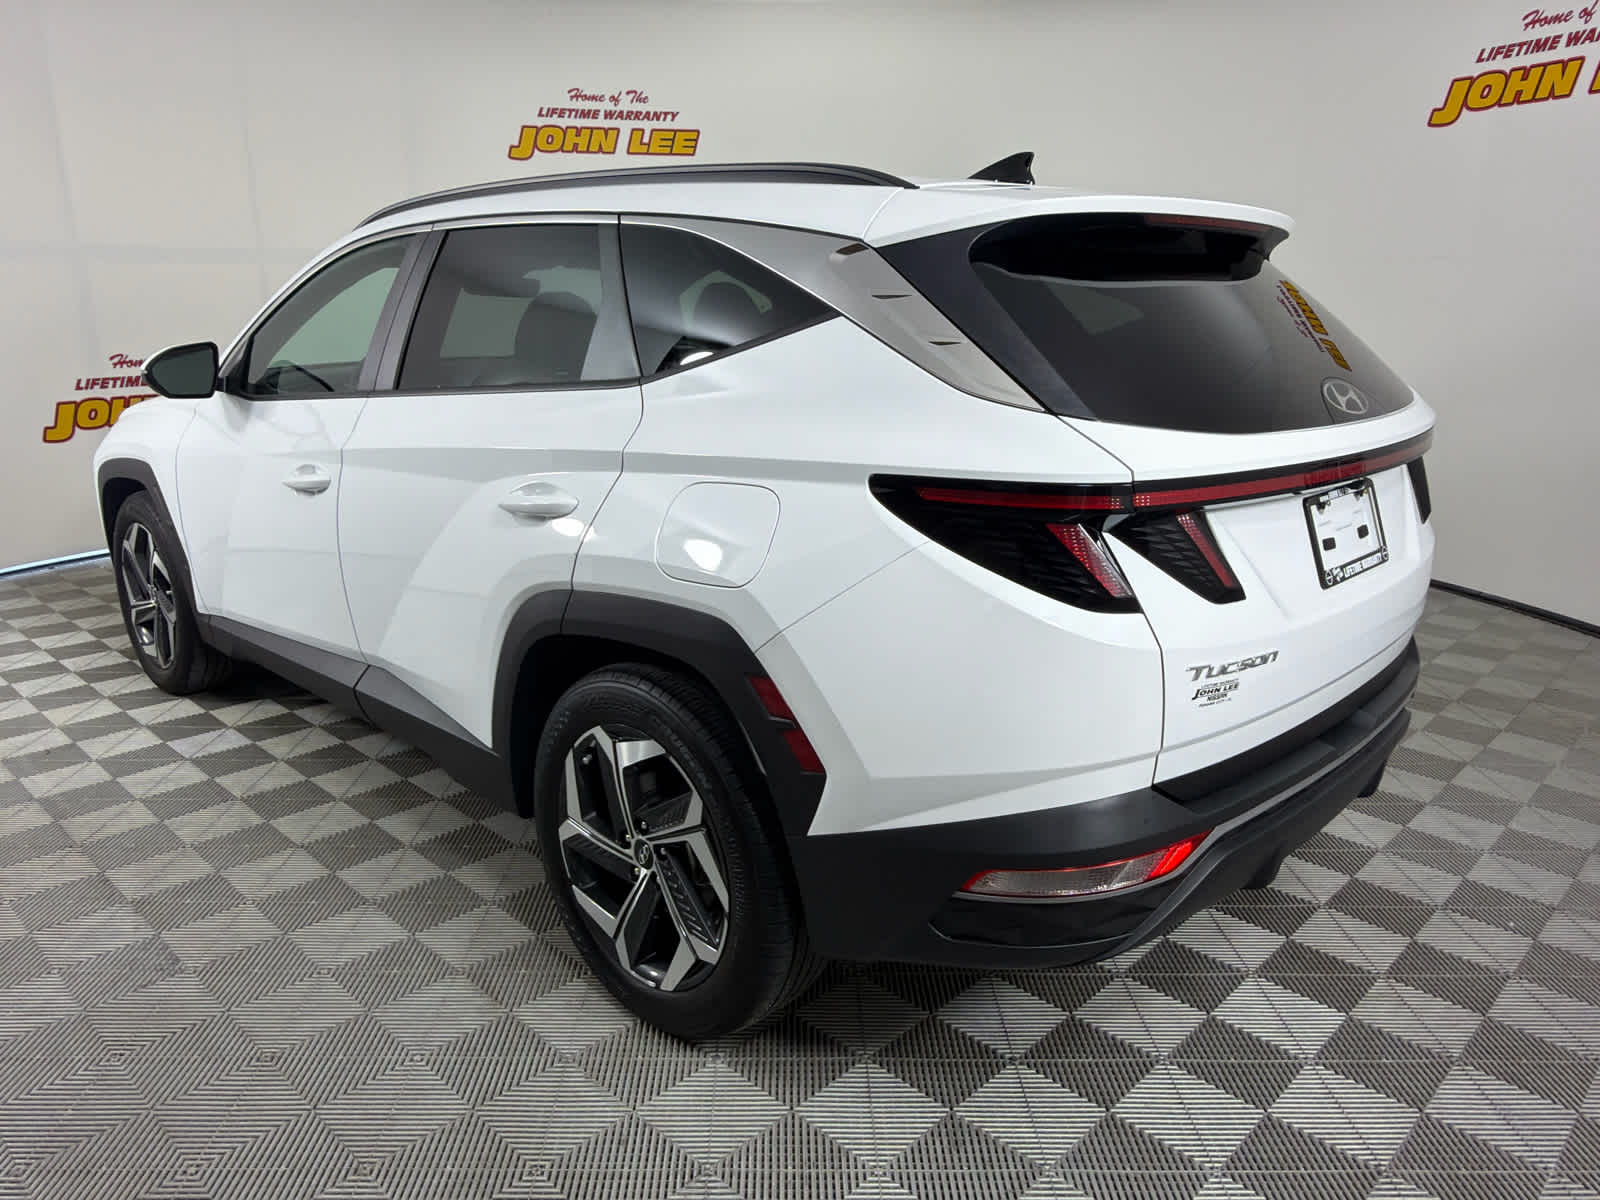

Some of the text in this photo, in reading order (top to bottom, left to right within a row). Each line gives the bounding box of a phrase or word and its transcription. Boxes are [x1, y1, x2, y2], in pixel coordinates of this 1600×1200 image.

[1521, 0, 1598, 32] Home of
[1475, 27, 1600, 64] LIFETIME WA
[567, 87, 649, 106] Home of The
[1427, 55, 1586, 128] JOHN
[537, 107, 680, 122] LIFETIME WARRANTY
[508, 124, 700, 161] JOHN LEE
[109, 353, 145, 369] Hom
[43, 394, 156, 443] JO
[1192, 688, 1221, 700] JOHN
